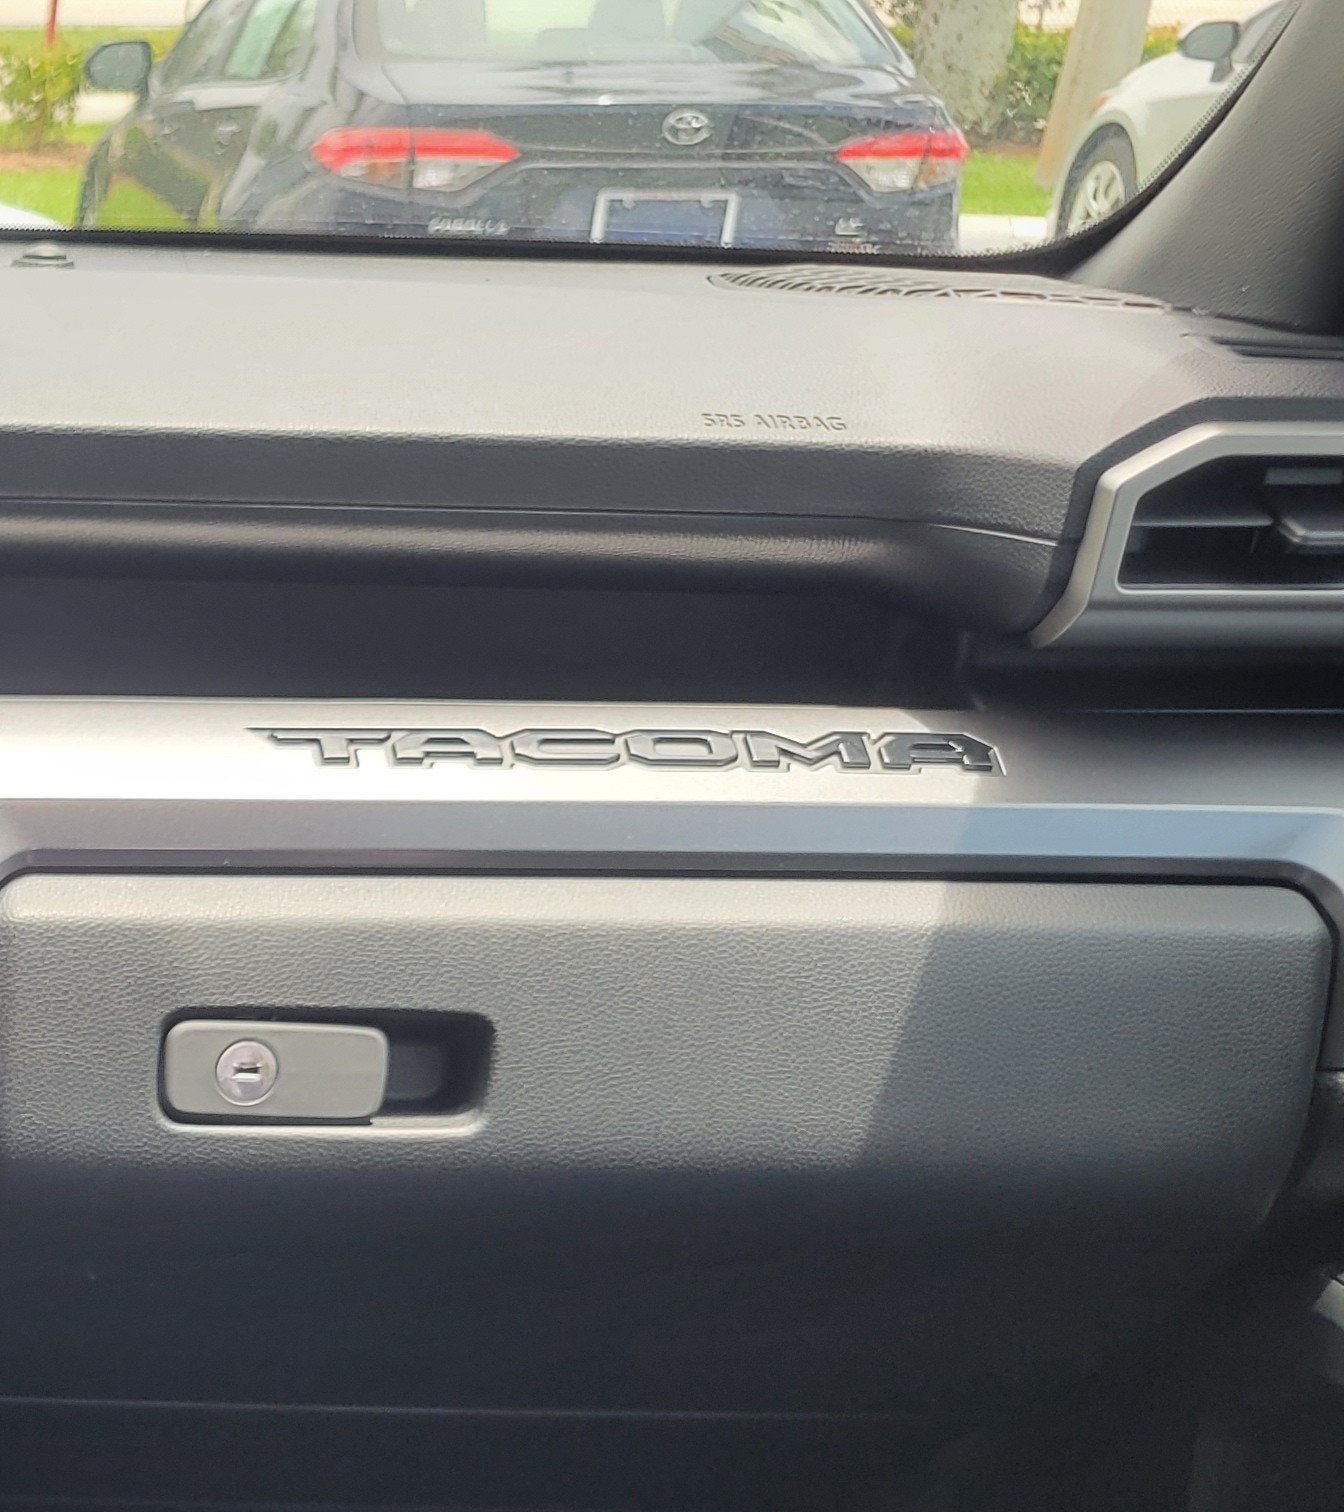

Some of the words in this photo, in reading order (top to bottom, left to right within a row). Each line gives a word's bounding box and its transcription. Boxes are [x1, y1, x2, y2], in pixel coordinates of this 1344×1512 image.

[701, 412, 746, 428] SRS
[754, 413, 848, 431] AIRBAG
[243, 725, 1007, 778] TACOMA
